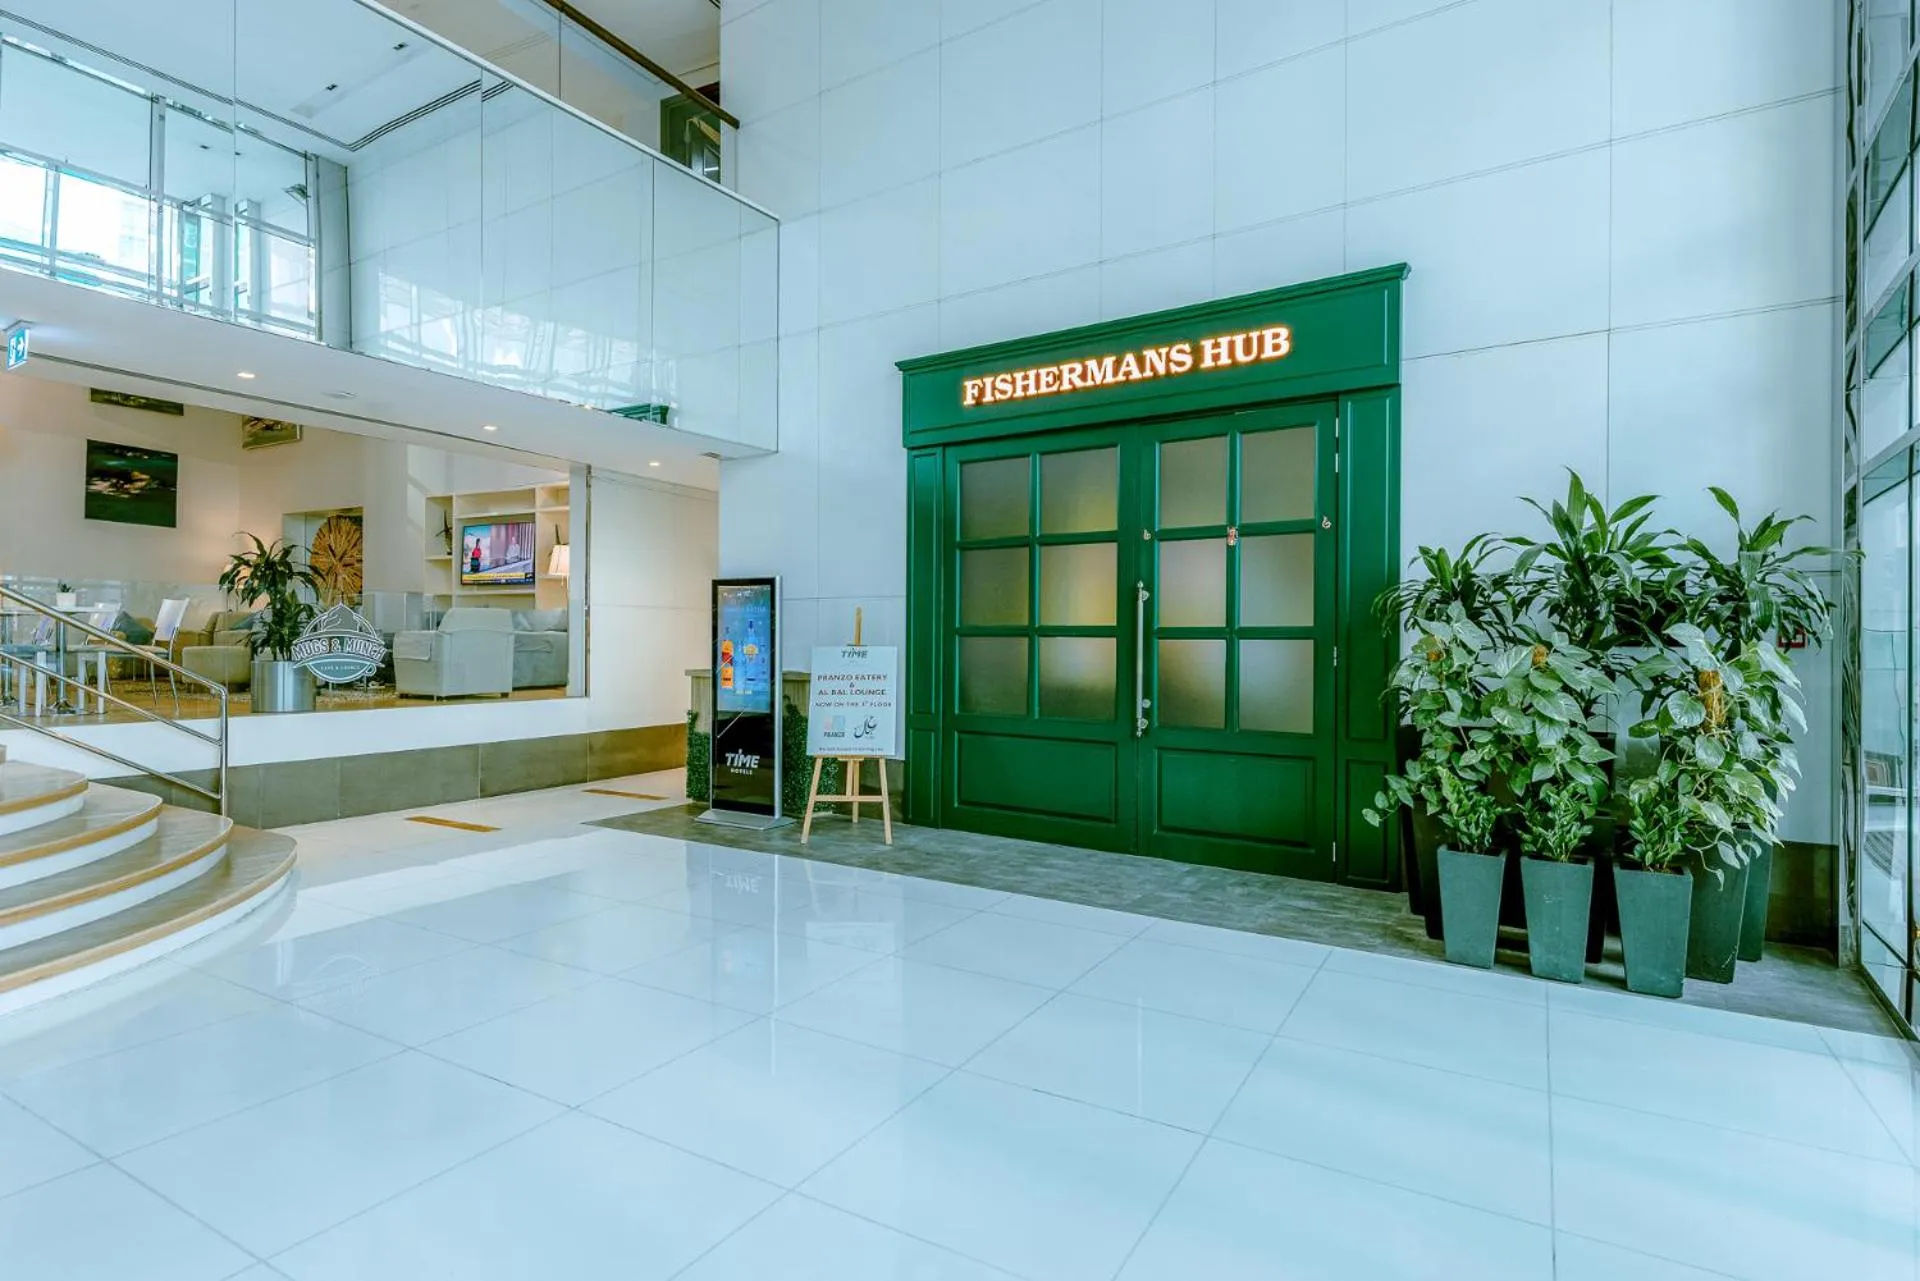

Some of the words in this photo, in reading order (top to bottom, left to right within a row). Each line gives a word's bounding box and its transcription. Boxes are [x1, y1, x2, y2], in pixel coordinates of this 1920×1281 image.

[962, 342, 1194, 406] FISHERMANS
[1199, 325, 1292, 370] HUB
[291, 639, 330, 661] MUGS
[331, 638, 341, 652] &
[344, 637, 387, 661] MUNCH
[841, 647, 868, 659] TIME
[817, 673, 853, 681] PRANZO
[854, 673, 887, 681] EATERY
[849, 688, 886, 696] LOUNGE
[725, 748, 761, 769] TIME
